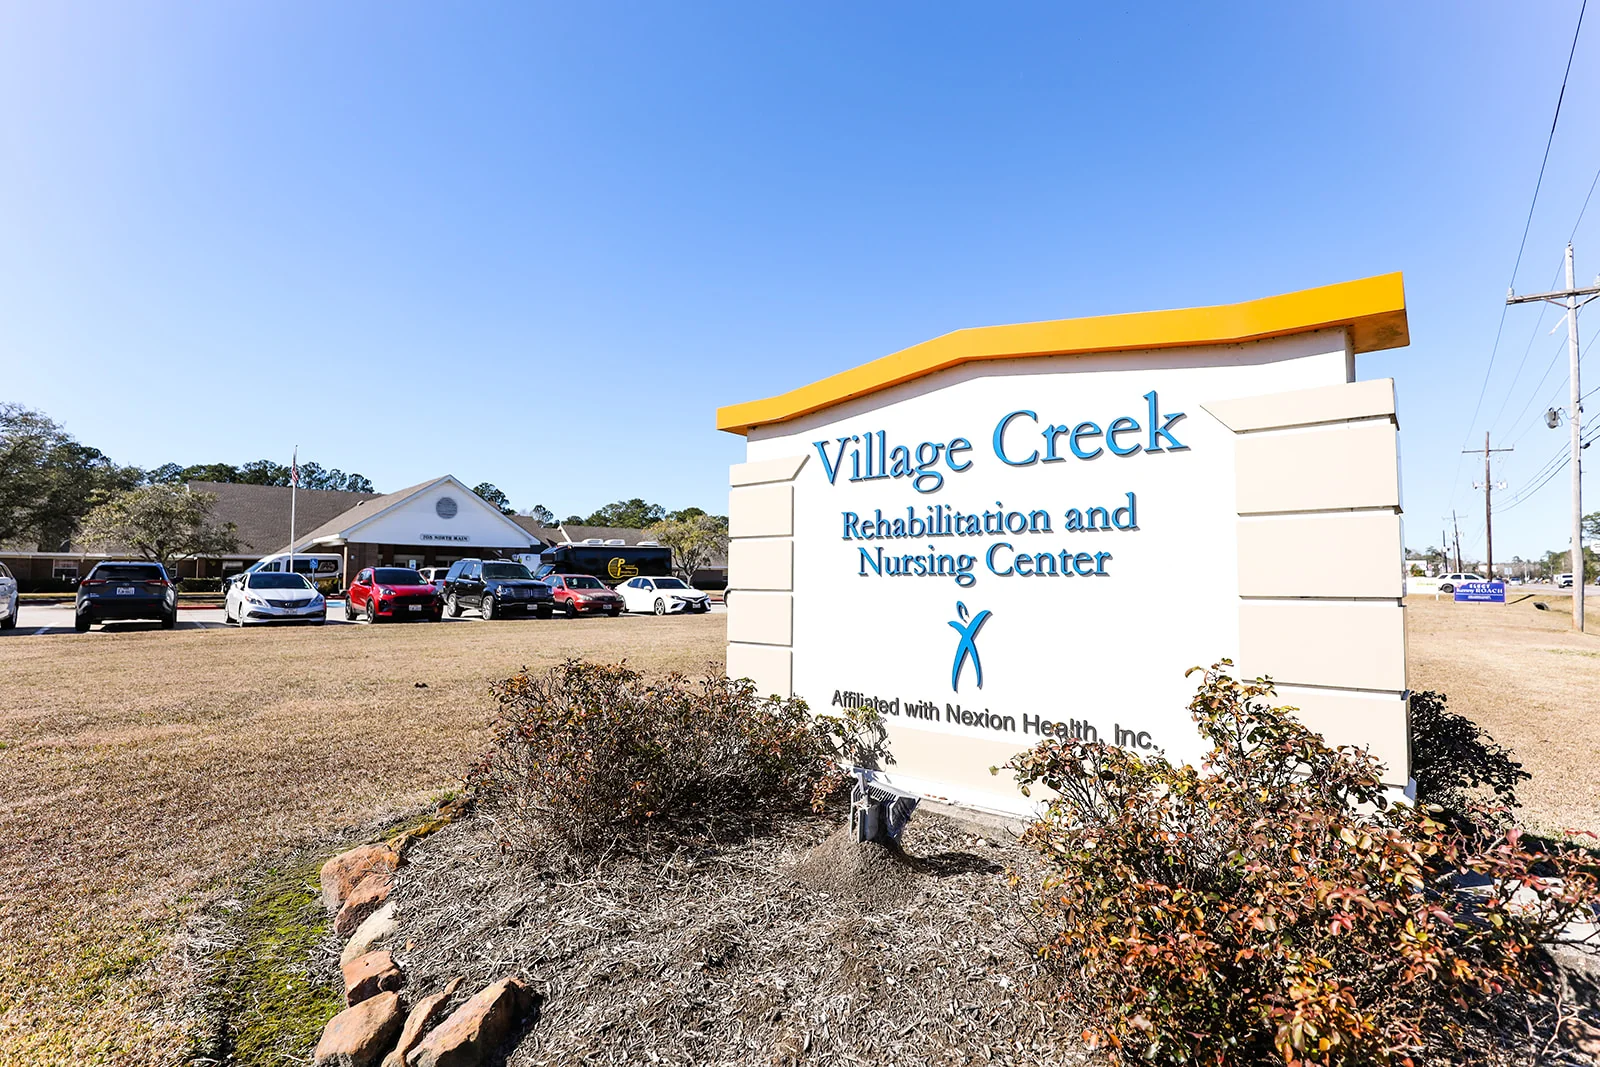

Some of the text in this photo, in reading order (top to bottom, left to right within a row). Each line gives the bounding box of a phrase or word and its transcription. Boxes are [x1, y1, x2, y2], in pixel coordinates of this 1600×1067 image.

[812, 390, 1191, 495] Village Creek
[841, 492, 1140, 542] Rehabilitation and
[857, 542, 1113, 588] Nursing Center
[831, 689, 900, 717] Affiliated
[904, 700, 940, 722] with
[946, 703, 1016, 732] Nexion
[1114, 723, 1159, 751] Inc.
